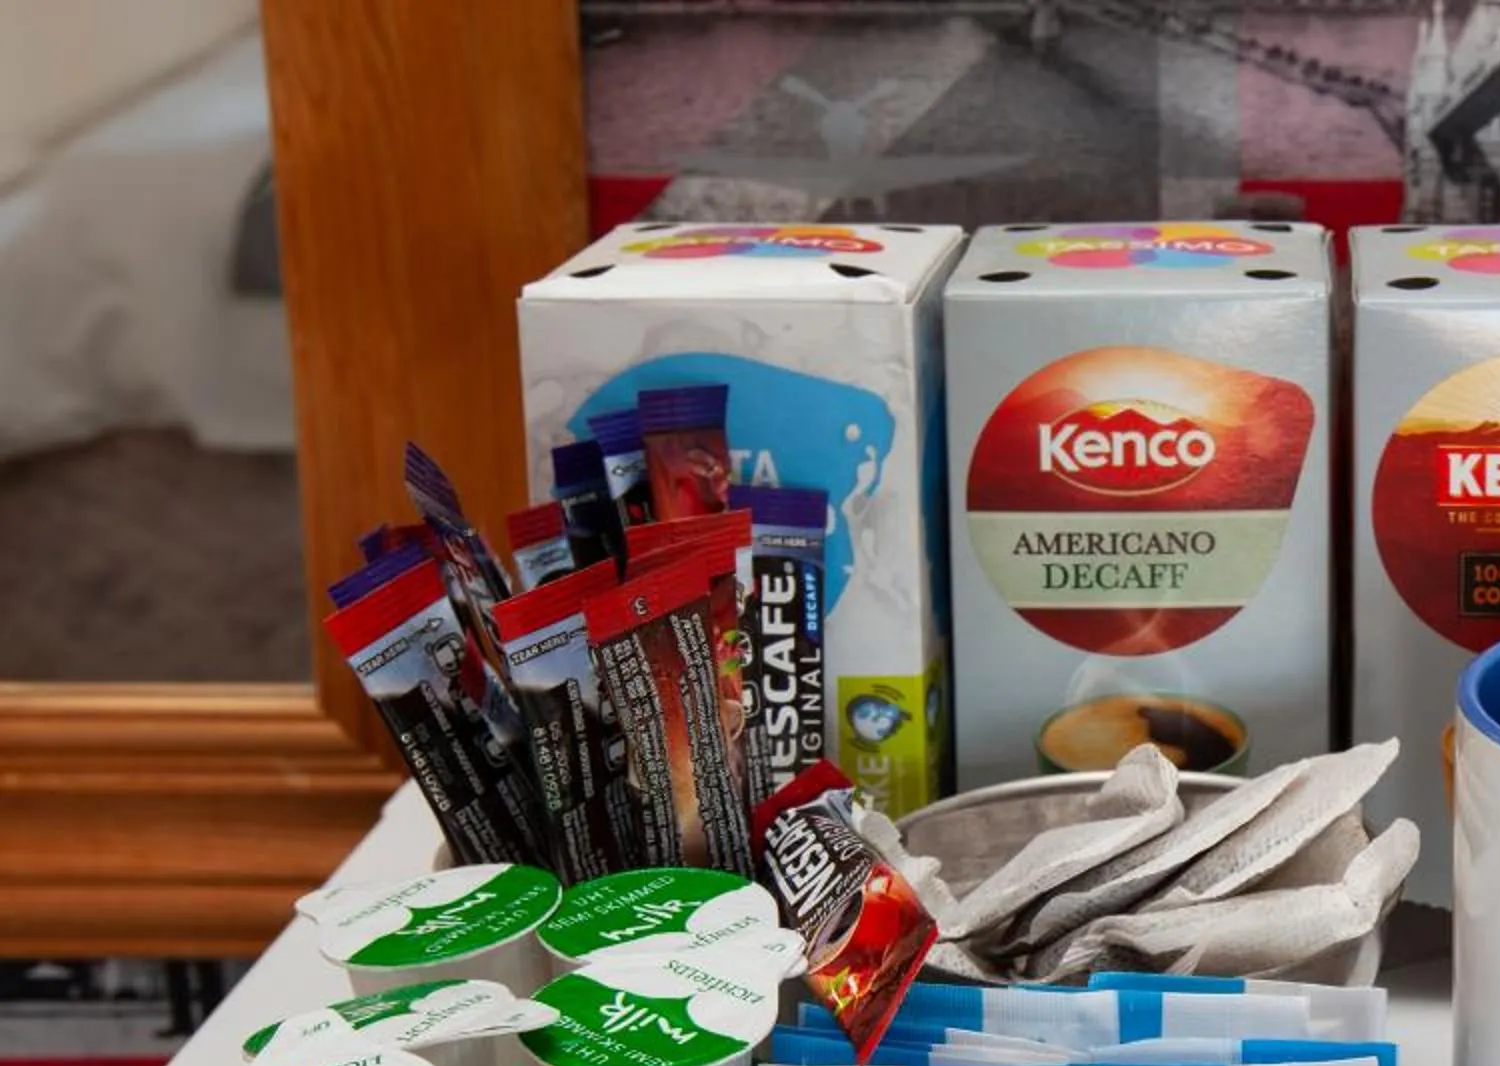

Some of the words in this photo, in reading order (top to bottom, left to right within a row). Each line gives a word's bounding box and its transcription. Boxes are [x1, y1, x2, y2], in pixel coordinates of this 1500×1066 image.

[1037, 421, 1217, 474] Kenco
[1448, 510, 1477, 524] THE
[1012, 529, 1217, 559] AMERICANO
[1042, 561, 1189, 591] DECAFF
[804, 572, 818, 632] DECAFF
[800, 647, 822, 768] IGINAL
[547, 912, 592, 931] SEMI
[599, 874, 675, 917] SKIMMED
[572, 884, 616, 908] UHT
[599, 899, 703, 941] milk
[557, 1014, 627, 1055] SKIMME
[599, 991, 699, 1045] milk
[563, 1040, 610, 1066] UHT
